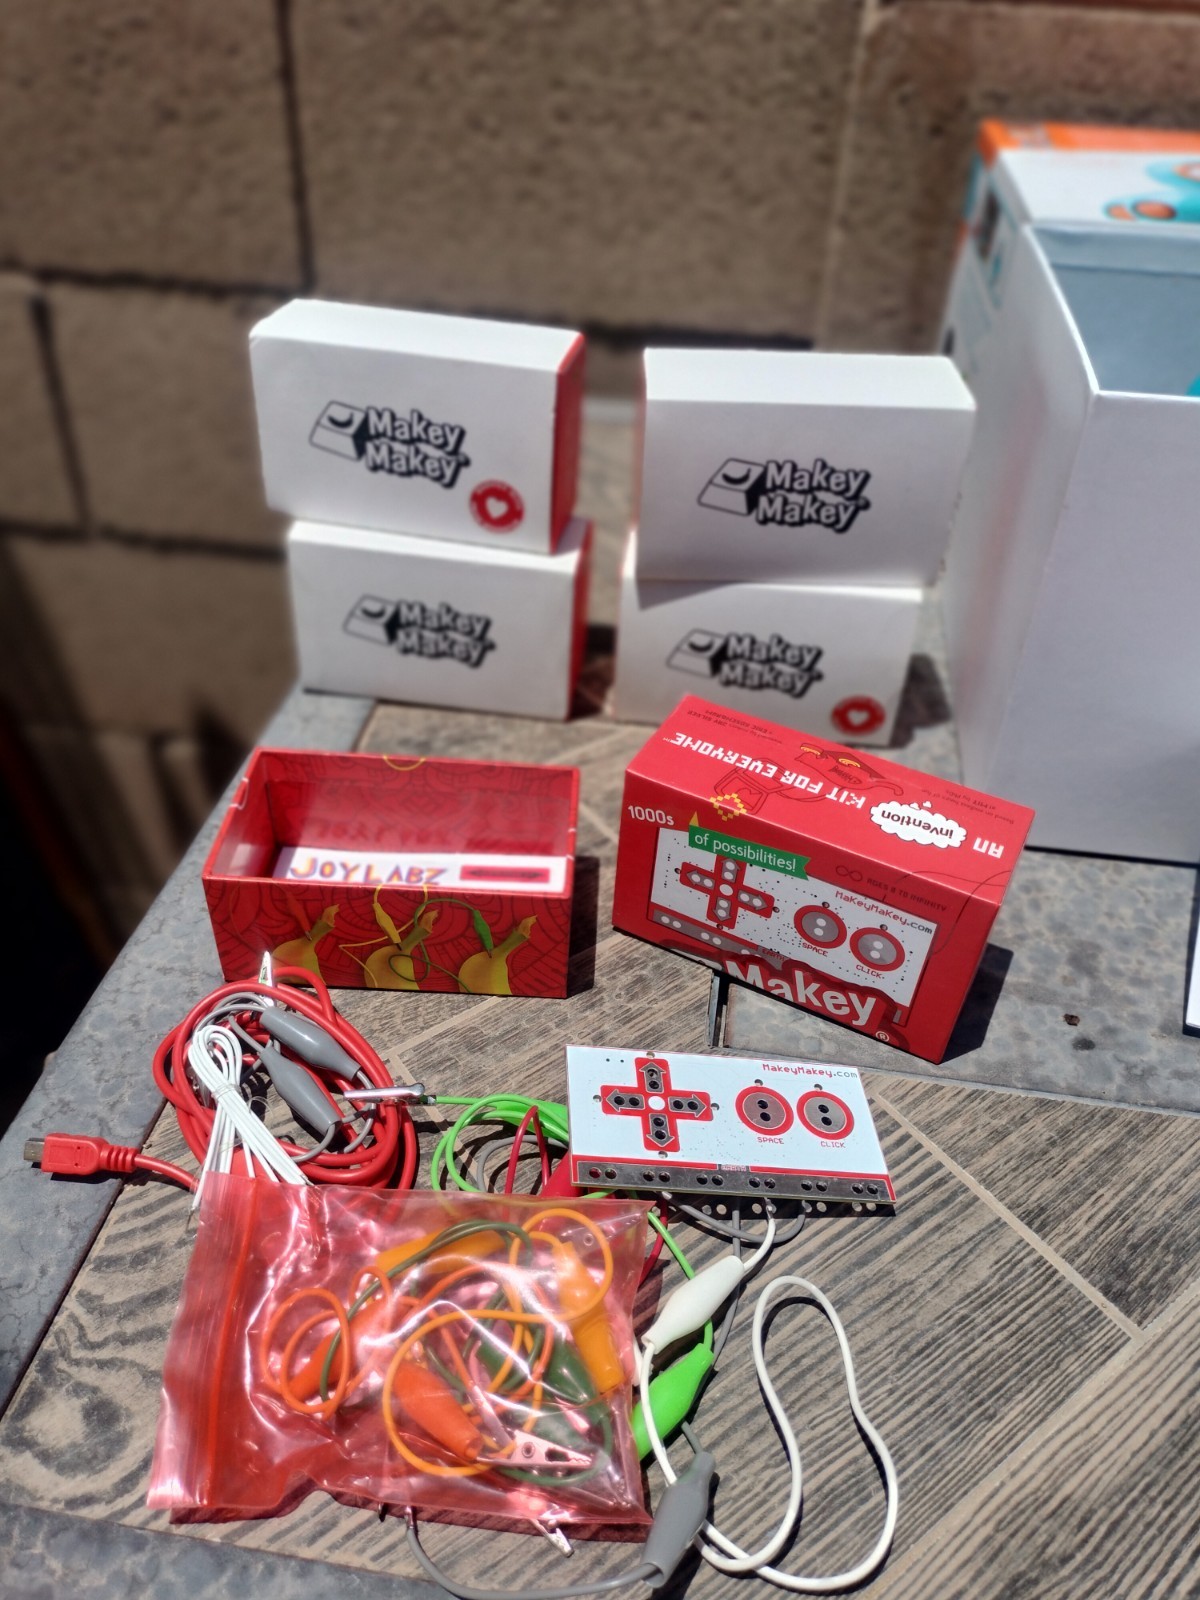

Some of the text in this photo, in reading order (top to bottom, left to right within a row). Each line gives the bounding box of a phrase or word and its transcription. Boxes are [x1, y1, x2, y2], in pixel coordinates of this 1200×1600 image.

[367, 406, 466, 453] Makey
[366, 441, 461, 489] Makey
[765, 458, 871, 501] Makey
[756, 493, 858, 534] Makey
[399, 599, 491, 642] Makey
[398, 630, 486, 669] Makey
[726, 632, 823, 674] Makey
[719, 660, 812, 698] Makey
[780, 770, 823, 794] FOR
[825, 787, 866, 809] KIT
[628, 805, 674, 825] 1000s
[881, 809, 955, 839] invention
[695, 833, 796, 872] of possibilities!
[972, 837, 1005, 859] AN
[290, 857, 447, 885] JOYLABZ
[801, 942, 828, 957] SPACE
[856, 964, 883, 979] CLICK
[725, 960, 876, 1026] Makey
[757, 1136, 784, 1145] SPACE
[820, 1140, 846, 1149] CLICK
